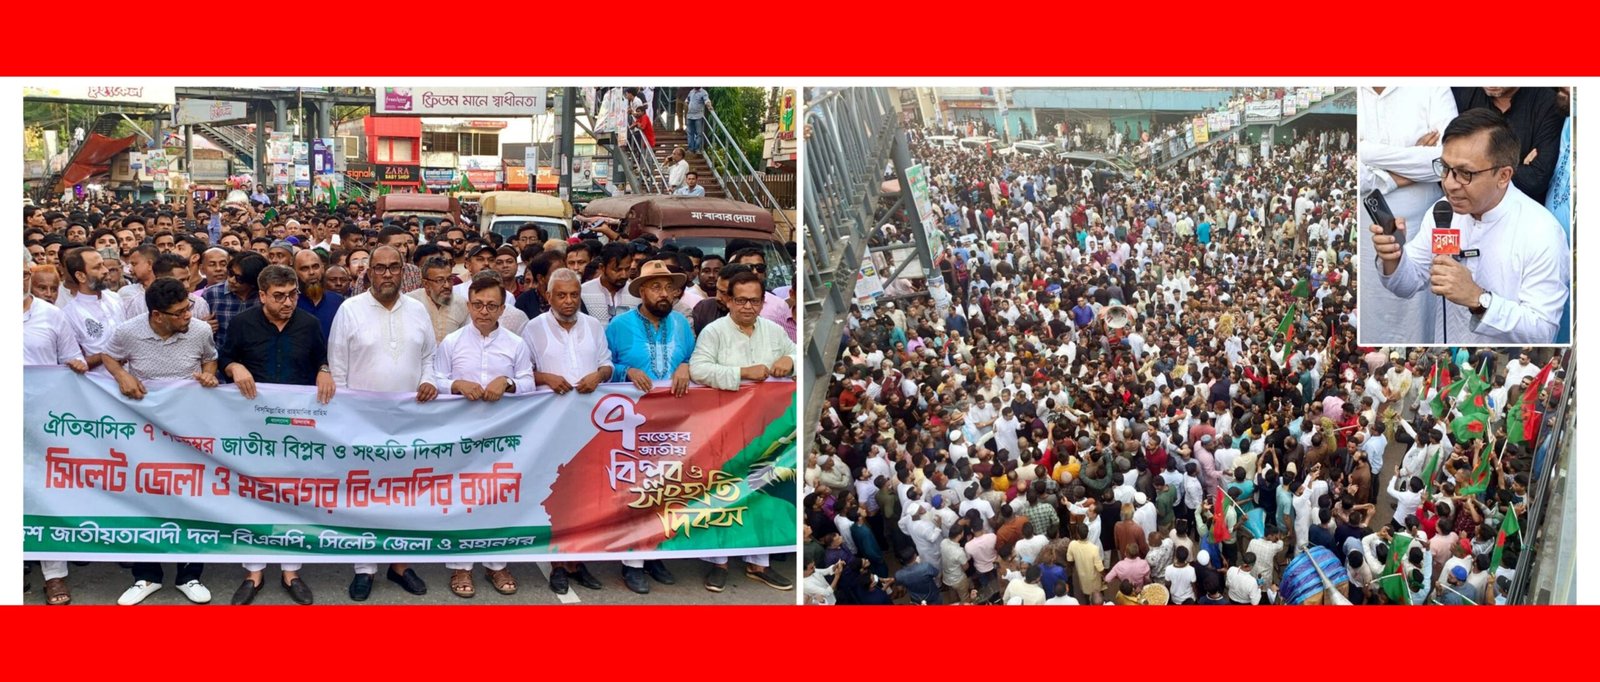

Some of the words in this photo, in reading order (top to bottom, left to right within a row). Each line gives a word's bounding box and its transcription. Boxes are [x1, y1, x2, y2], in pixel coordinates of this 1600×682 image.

[422, 91, 459, 108] ফ্রিডম
[462, 95, 488, 106] মানে
[492, 92, 537, 107] স্বাধীনতা
[385, 167, 410, 175] ZARA
[1433, 233, 1459, 250] সুরমা
[44, 411, 137, 440] ঐতিহাসিক
[143, 424, 155, 441] ৭
[221, 431, 277, 457] জাতীয়
[282, 435, 327, 461] বিপ্লব
[332, 444, 347, 460] ও
[352, 439, 407, 462] সংহতি
[411, 438, 455, 460] দিবস
[460, 434, 522, 454] উপলক্ষে
[591, 394, 647, 451] ৭
[638, 432, 692, 443] নভেম্বর
[638, 443, 687, 457] জাতীয়
[45, 447, 128, 492] সিলেট
[135, 462, 206, 497] জেলা
[212, 466, 231, 496] ও
[238, 472, 340, 514] মহানগর
[346, 467, 453, 514] বিএনপির
[605, 448, 683, 491] বিপ্লব
[685, 465, 703, 479] ও
[628, 470, 745, 509] সংহতি
[50, 521, 182, 545] জাতীয়তাবাদী
[318, 530, 377, 550] সিলেট
[382, 536, 433, 550] জেলা
[437, 538, 452, 550] ও
[458, 535, 536, 549] মহানগর
[656, 501, 749, 539] দিবস
